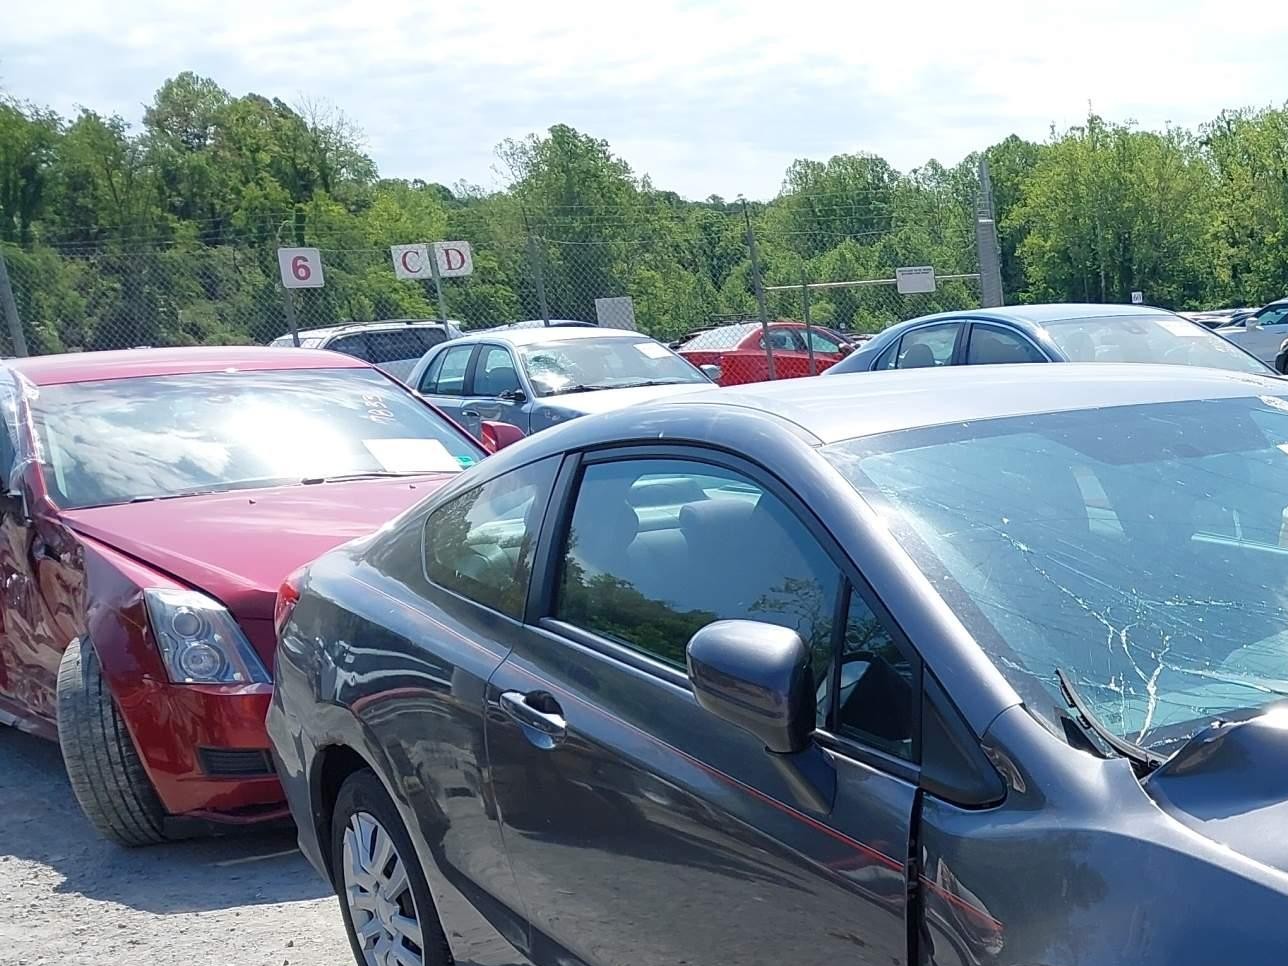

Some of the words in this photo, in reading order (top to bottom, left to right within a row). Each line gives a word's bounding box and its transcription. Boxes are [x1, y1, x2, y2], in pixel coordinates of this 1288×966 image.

[291, 255, 312, 281] 6
[401, 250, 422, 274] C
[443, 248, 466, 271] D
